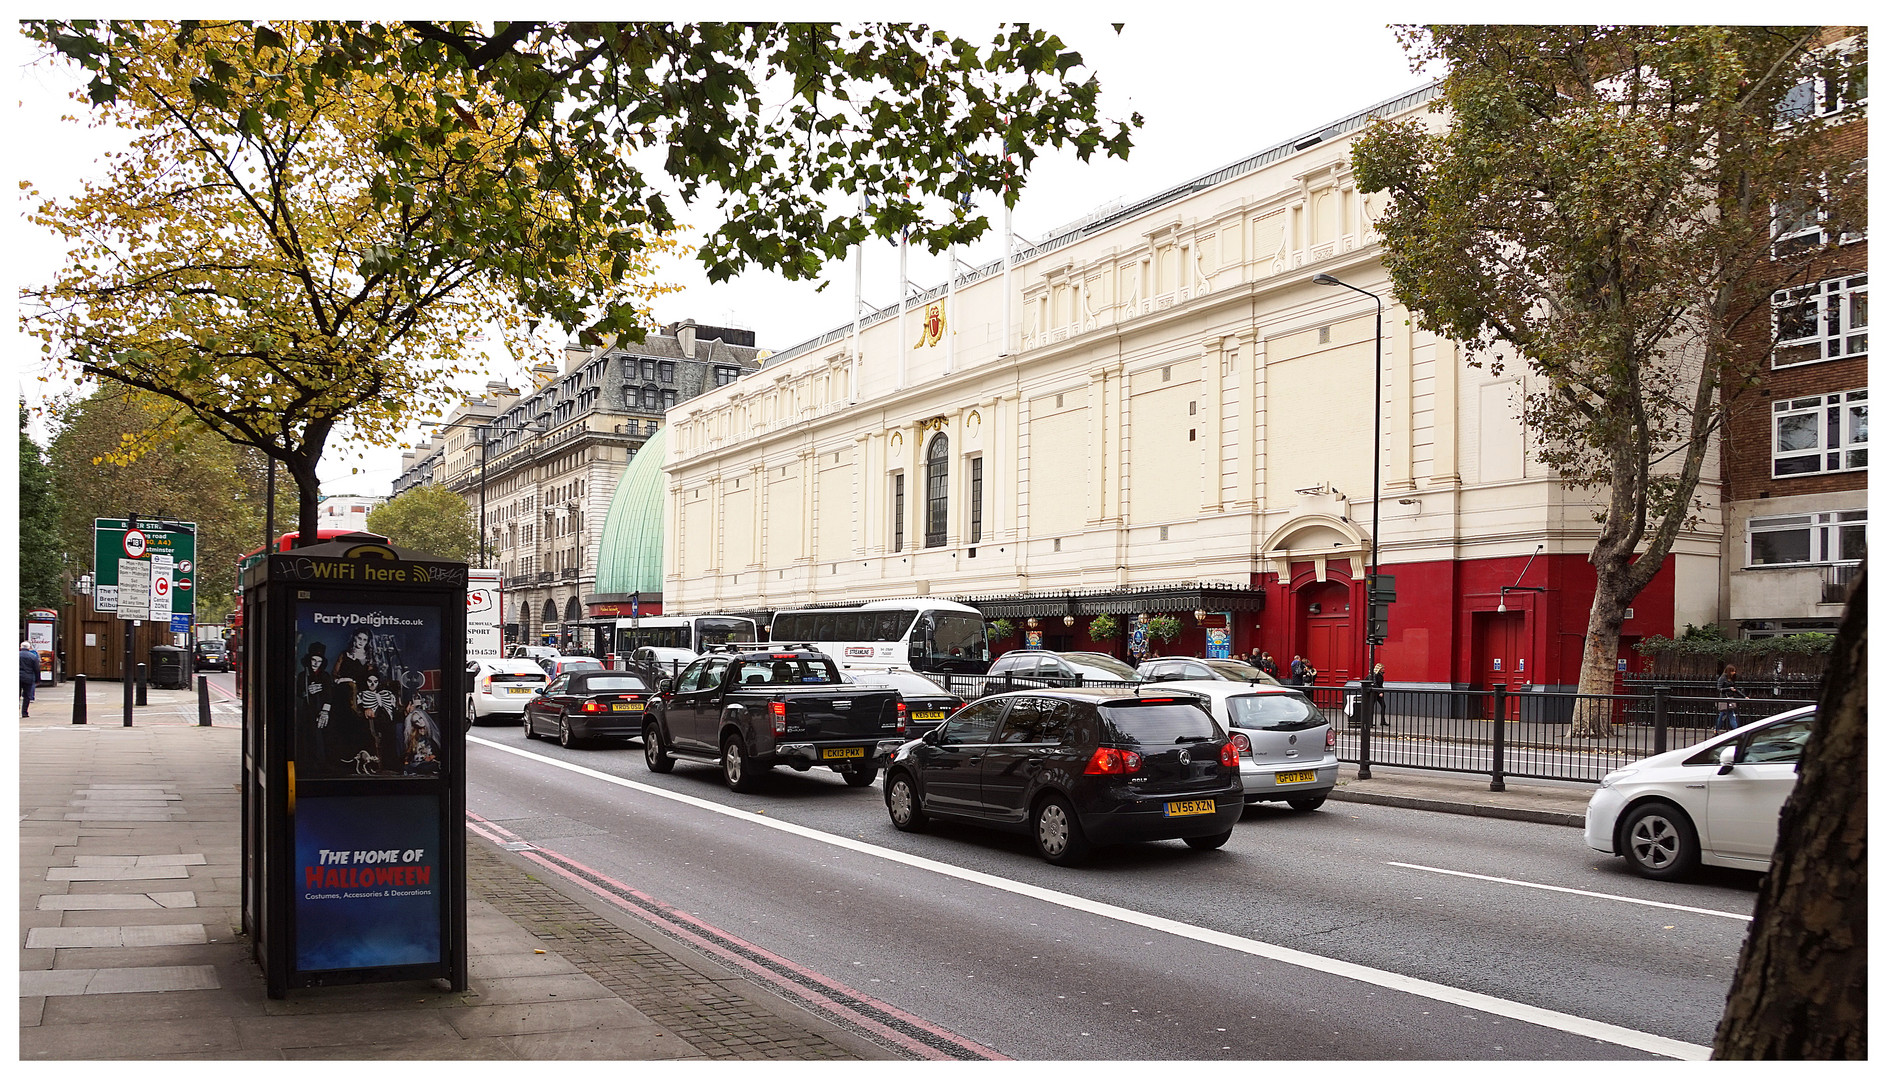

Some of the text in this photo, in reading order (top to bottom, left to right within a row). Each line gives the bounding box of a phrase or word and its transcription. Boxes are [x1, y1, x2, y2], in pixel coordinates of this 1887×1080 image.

[312, 561, 355, 580] WiFi
[365, 564, 406, 582] here
[827, 749, 844, 757] CK13
[1279, 771, 1313, 783] GF07 BXU
[1169, 800, 1213, 813] LV56 XZN
[319, 849, 425, 865] THE HOME OF
[305, 866, 431, 889] HALLOWEEN
[343, 890, 383, 899] Accessories
[391, 889, 432, 897] Decorations
